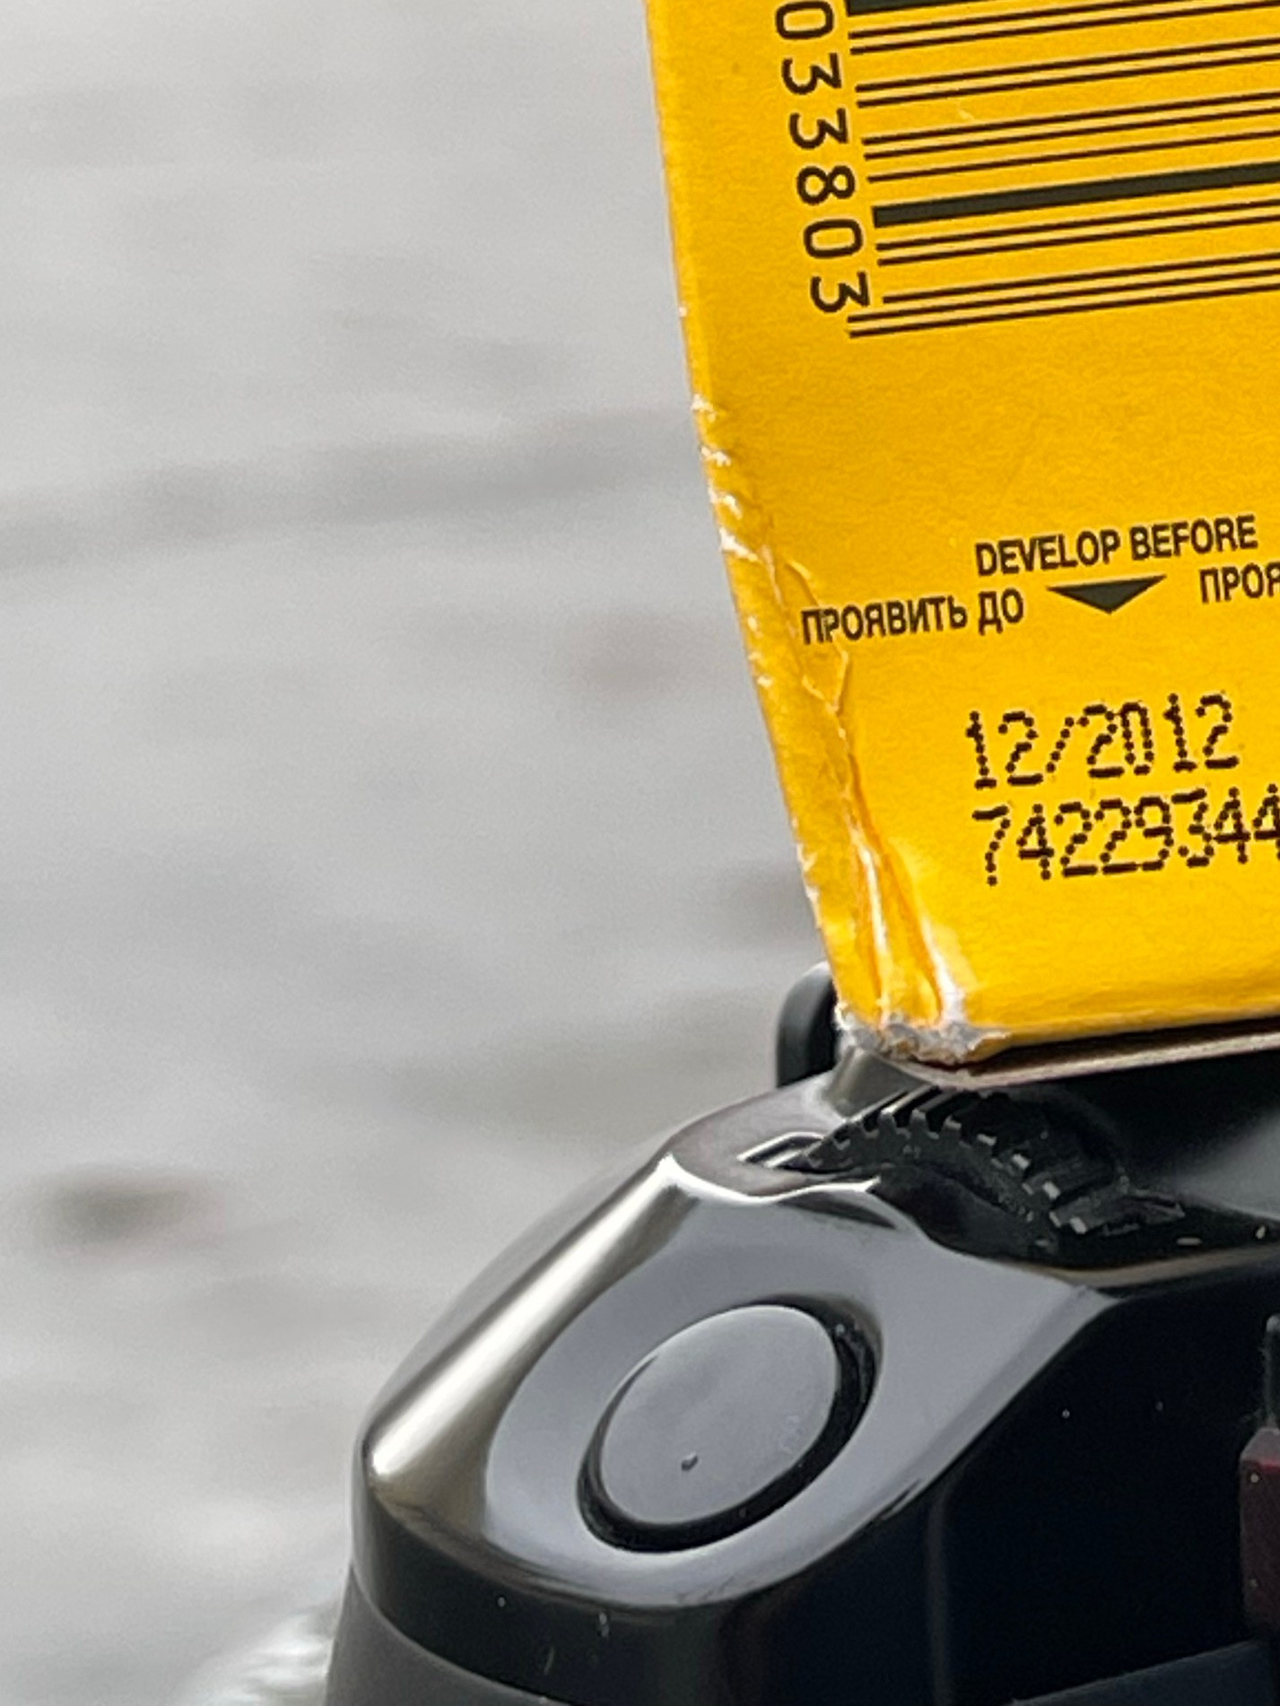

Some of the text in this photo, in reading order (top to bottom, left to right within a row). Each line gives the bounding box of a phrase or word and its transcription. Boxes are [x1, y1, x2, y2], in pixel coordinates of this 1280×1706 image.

[975, 514, 1258, 577] DEVELOP BEFORE
[801, 587, 1024, 645] ПРОЯВИТЬ ДО
[966, 692, 1239, 789] 12/2012
